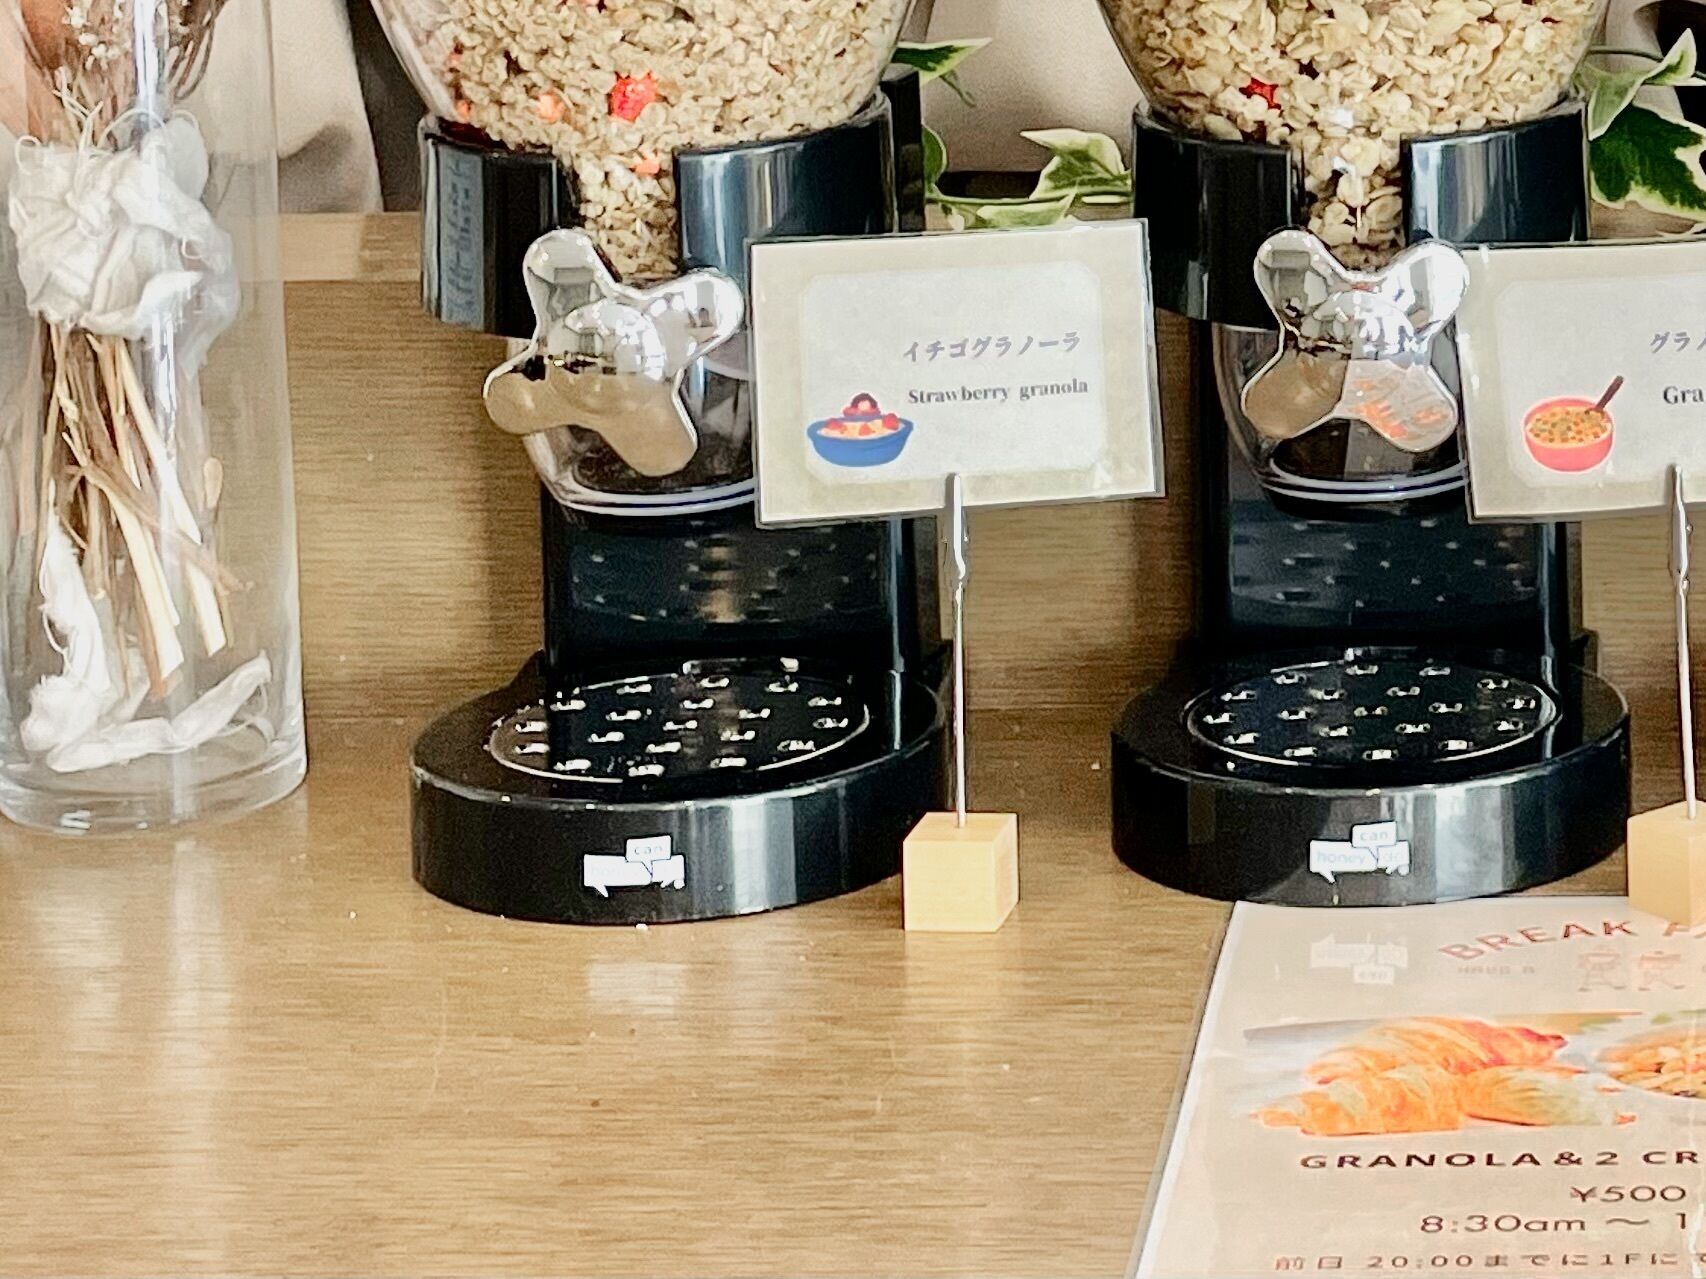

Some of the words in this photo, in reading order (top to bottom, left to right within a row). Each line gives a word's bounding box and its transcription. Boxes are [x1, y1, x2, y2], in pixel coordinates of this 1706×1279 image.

[903, 331, 1082, 363] イチゴグラノーラ
[907, 385, 1010, 404] Strawberry
[1018, 377, 1089, 402] granola
[1359, 829, 1389, 842] can
[632, 843, 663, 856] can
[1316, 849, 1367, 865] honey
[1439, 920, 1638, 961] BREAK
[1570, 1184, 1687, 1203] ¥500
[1419, 1214, 1586, 1233] 8:30am
